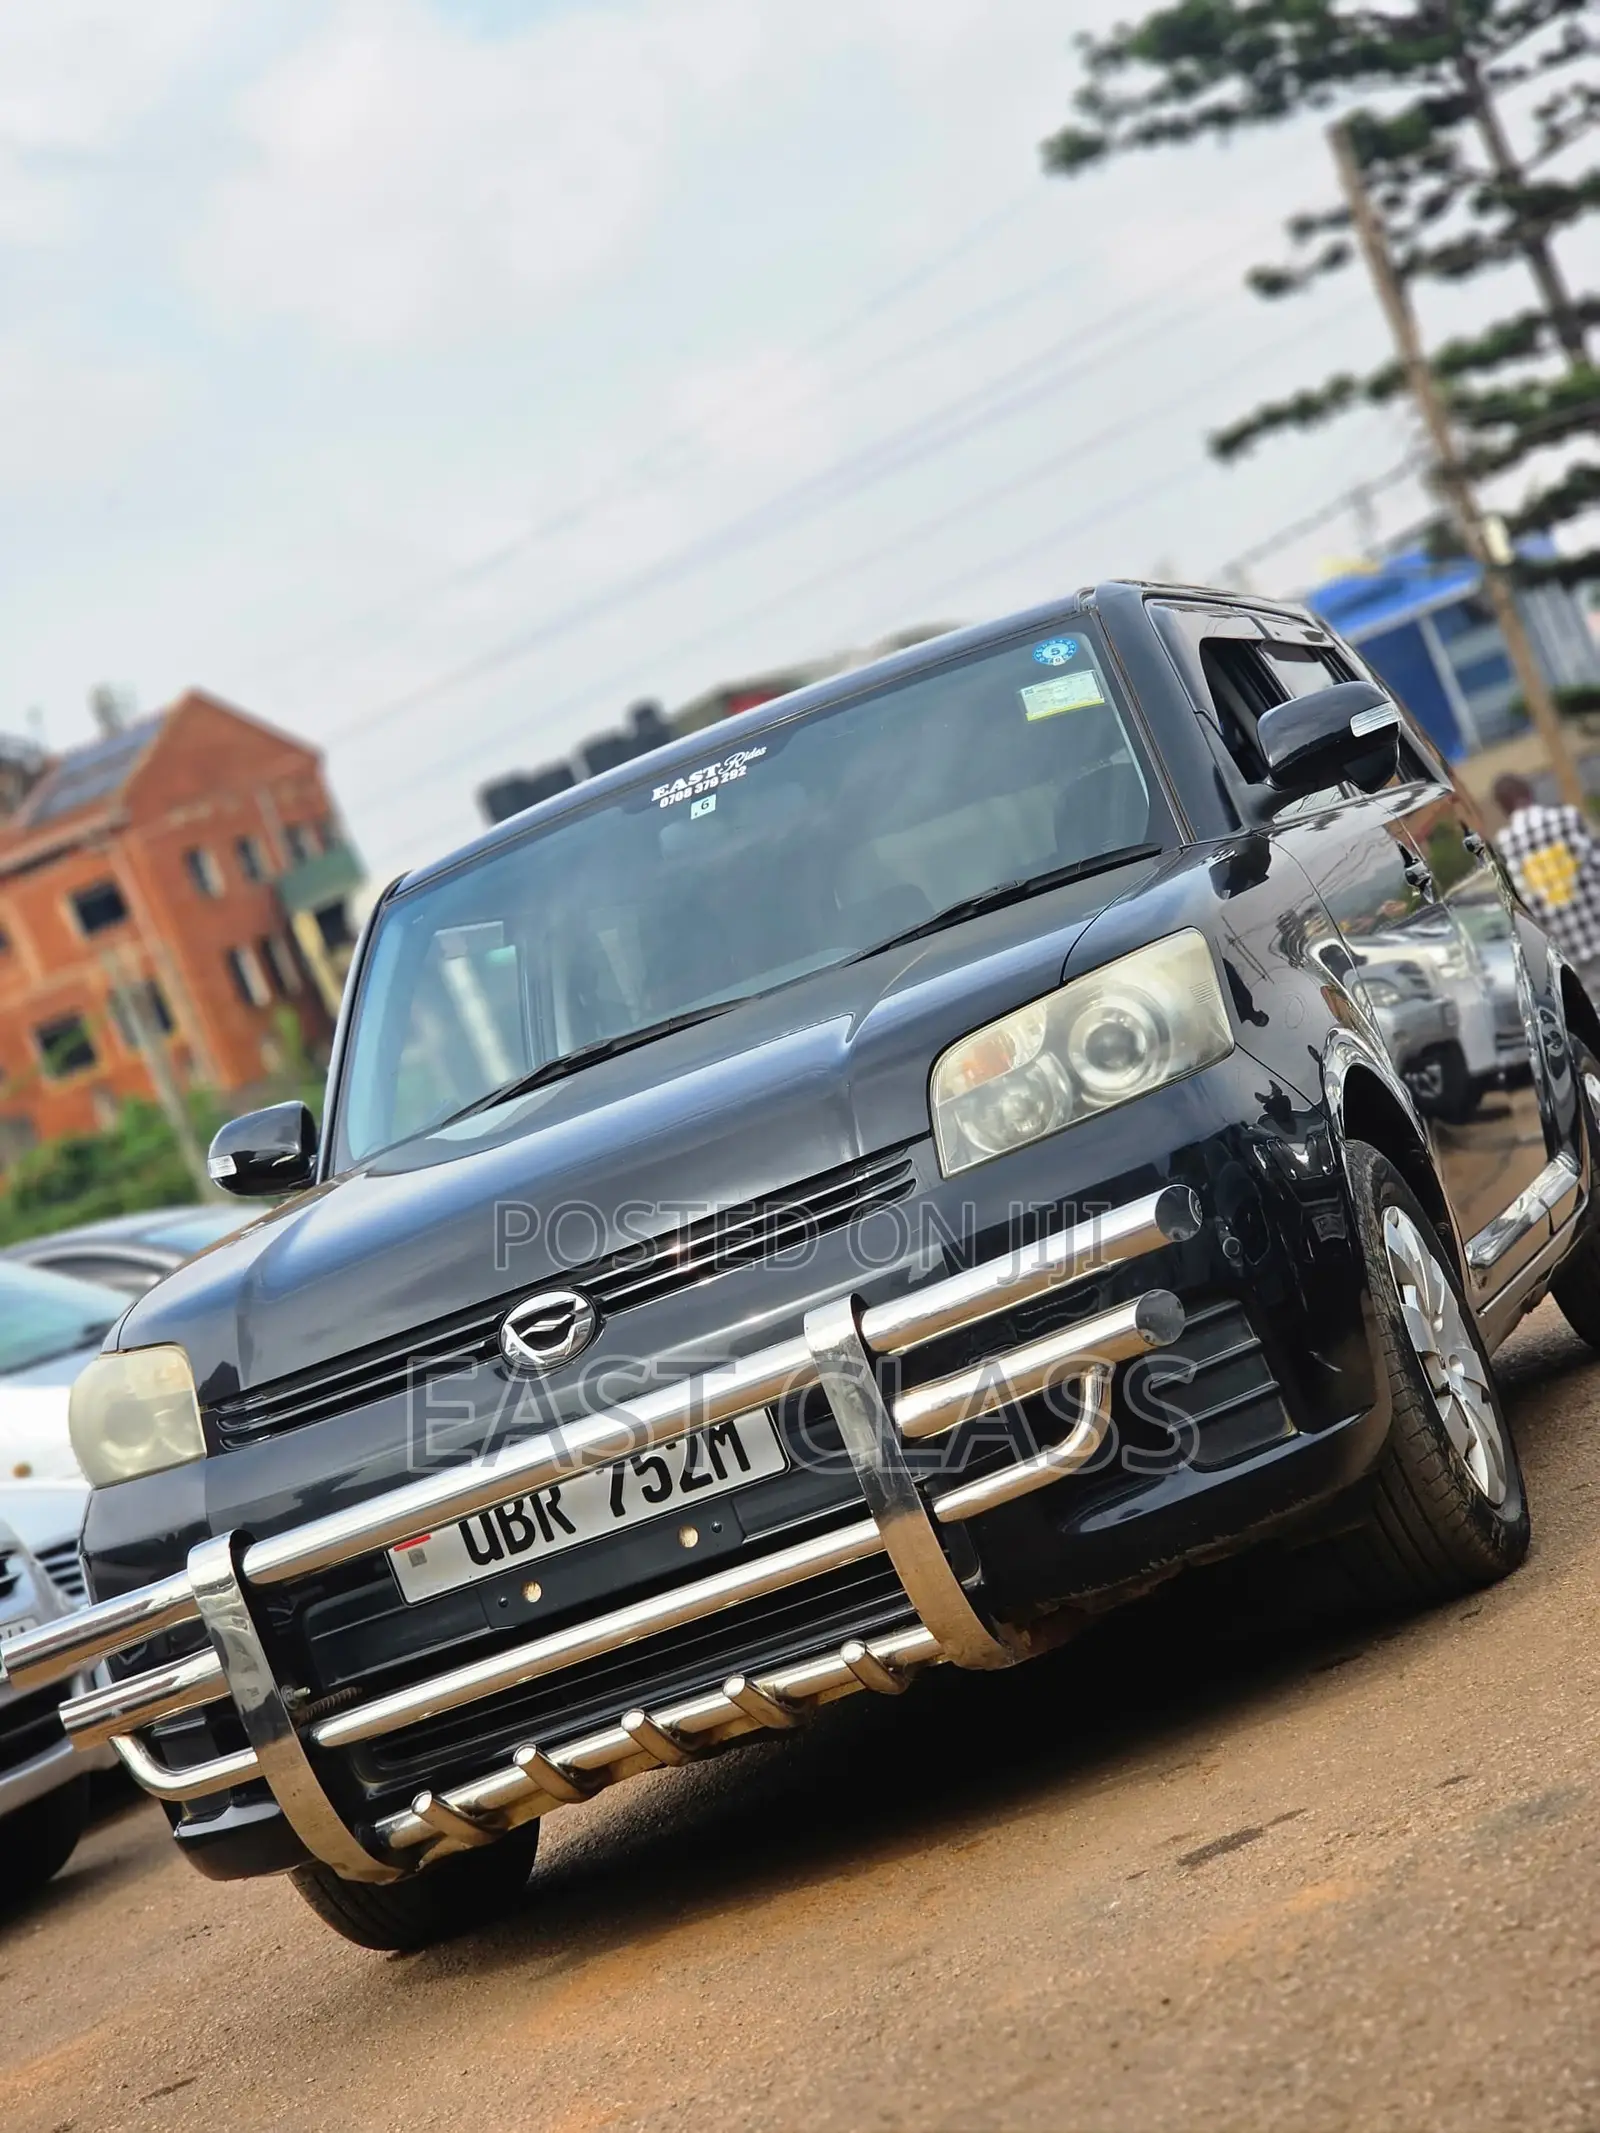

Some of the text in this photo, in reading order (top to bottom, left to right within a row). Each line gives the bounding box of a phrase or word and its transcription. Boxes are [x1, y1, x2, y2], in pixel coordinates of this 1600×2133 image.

[652, 747, 768, 801] EAST Rides
[660, 786, 692, 808] 0708
[458, 1420, 751, 1566] UBR 752M
